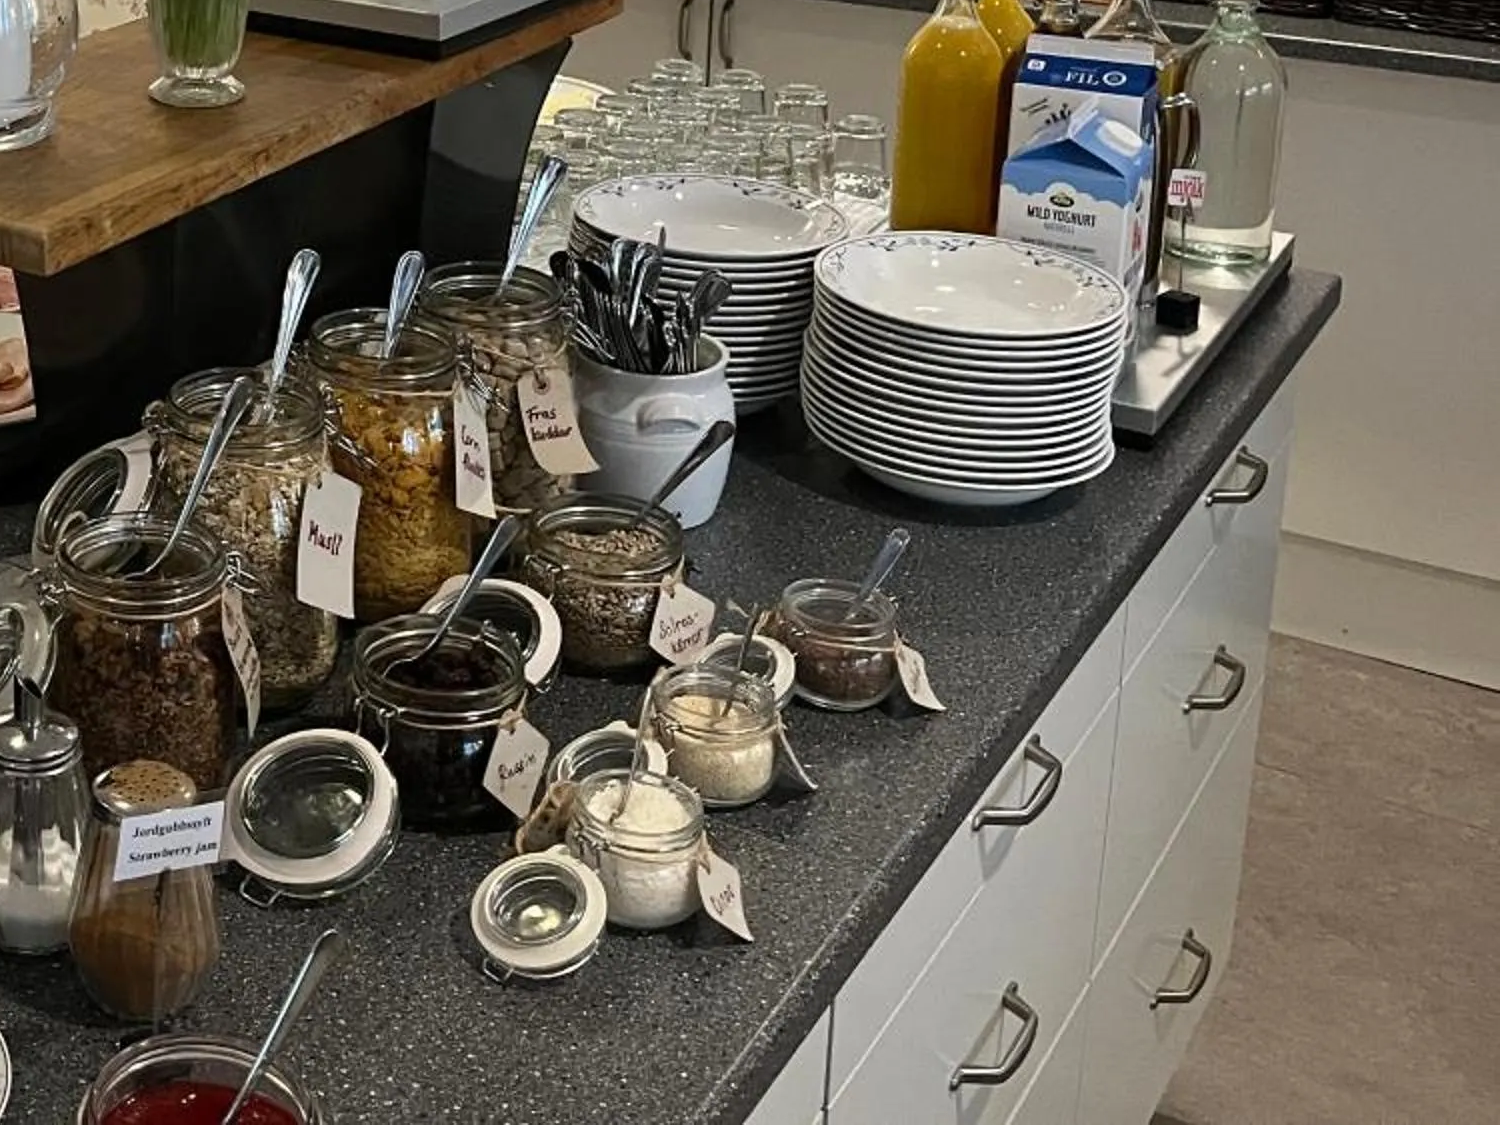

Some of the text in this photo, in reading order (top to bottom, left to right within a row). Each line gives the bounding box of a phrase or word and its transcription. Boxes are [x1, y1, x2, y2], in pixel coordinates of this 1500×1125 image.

[1064, 70, 1100, 87] FIL
[1052, 209, 1097, 228] YOGHURT
[128, 841, 218, 863] Strawberry jam
